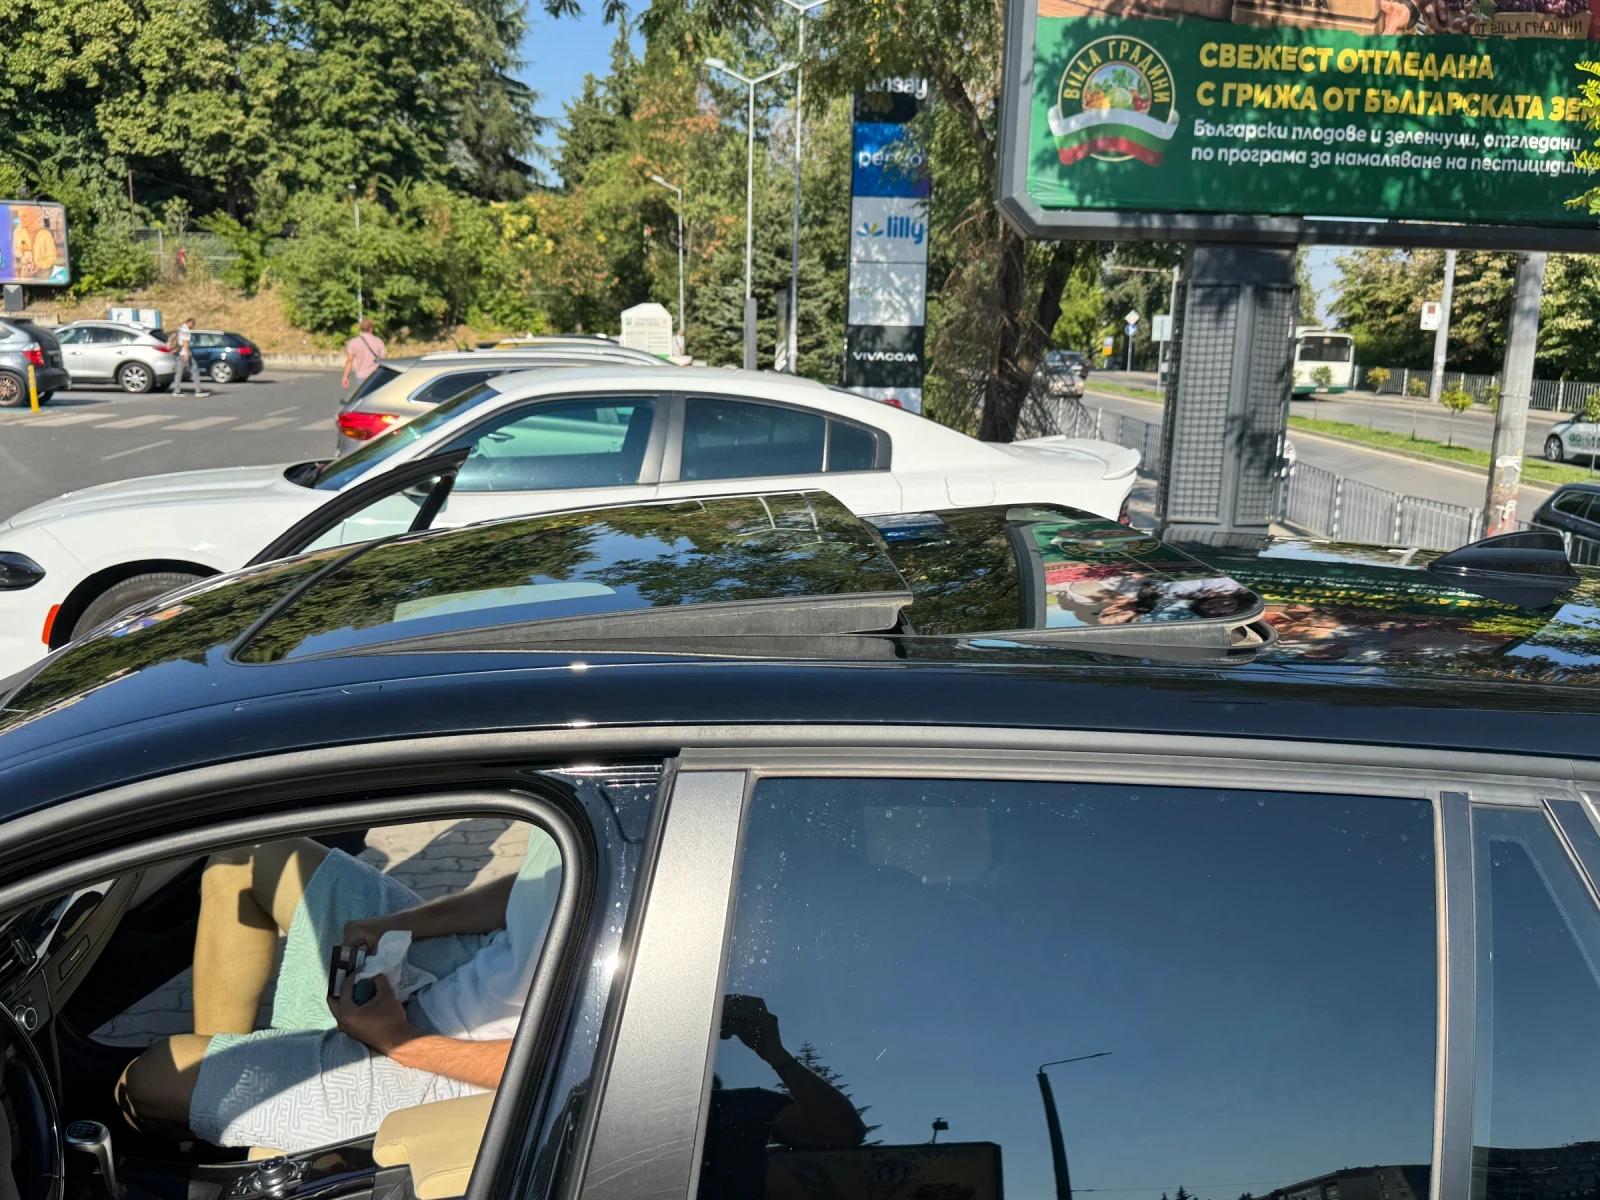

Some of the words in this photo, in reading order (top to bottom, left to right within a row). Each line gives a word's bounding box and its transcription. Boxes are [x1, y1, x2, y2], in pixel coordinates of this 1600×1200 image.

[1474, 23, 1487, 35] ОТ
[1490, 21, 1521, 35] BILLA
[1524, 20, 1583, 35] ГРАДИНИ
[1063, 49, 1102, 99] BILLA
[1108, 41, 1170, 102] ГРАДИНИ
[1199, 42, 1334, 73] СВЕЖЕСТ
[1336, 48, 1494, 82] ОТГЛЕДАНА
[1196, 81, 1216, 107] С
[1221, 83, 1318, 111] ГРИЖА
[1323, 86, 1361, 112] ОТ
[1364, 88, 1544, 121] БЪЛГАРСКАТА
[1193, 118, 1288, 142] Български
[1291, 124, 1367, 145] плодове
[1370, 129, 1382, 143] и
[1384, 130, 1480, 149] зеленчуци,
[1483, 134, 1582, 154] отгледани
[858, 150, 922, 169] peo
[1191, 147, 1214, 161] по
[1217, 148, 1307, 167] програма
[1309, 151, 1331, 169] за
[1334, 150, 1442, 169] намаляване
[1446, 156, 1467, 170] на
[886, 215, 925, 245] lilly
[852, 351, 918, 362] VIVACOM
